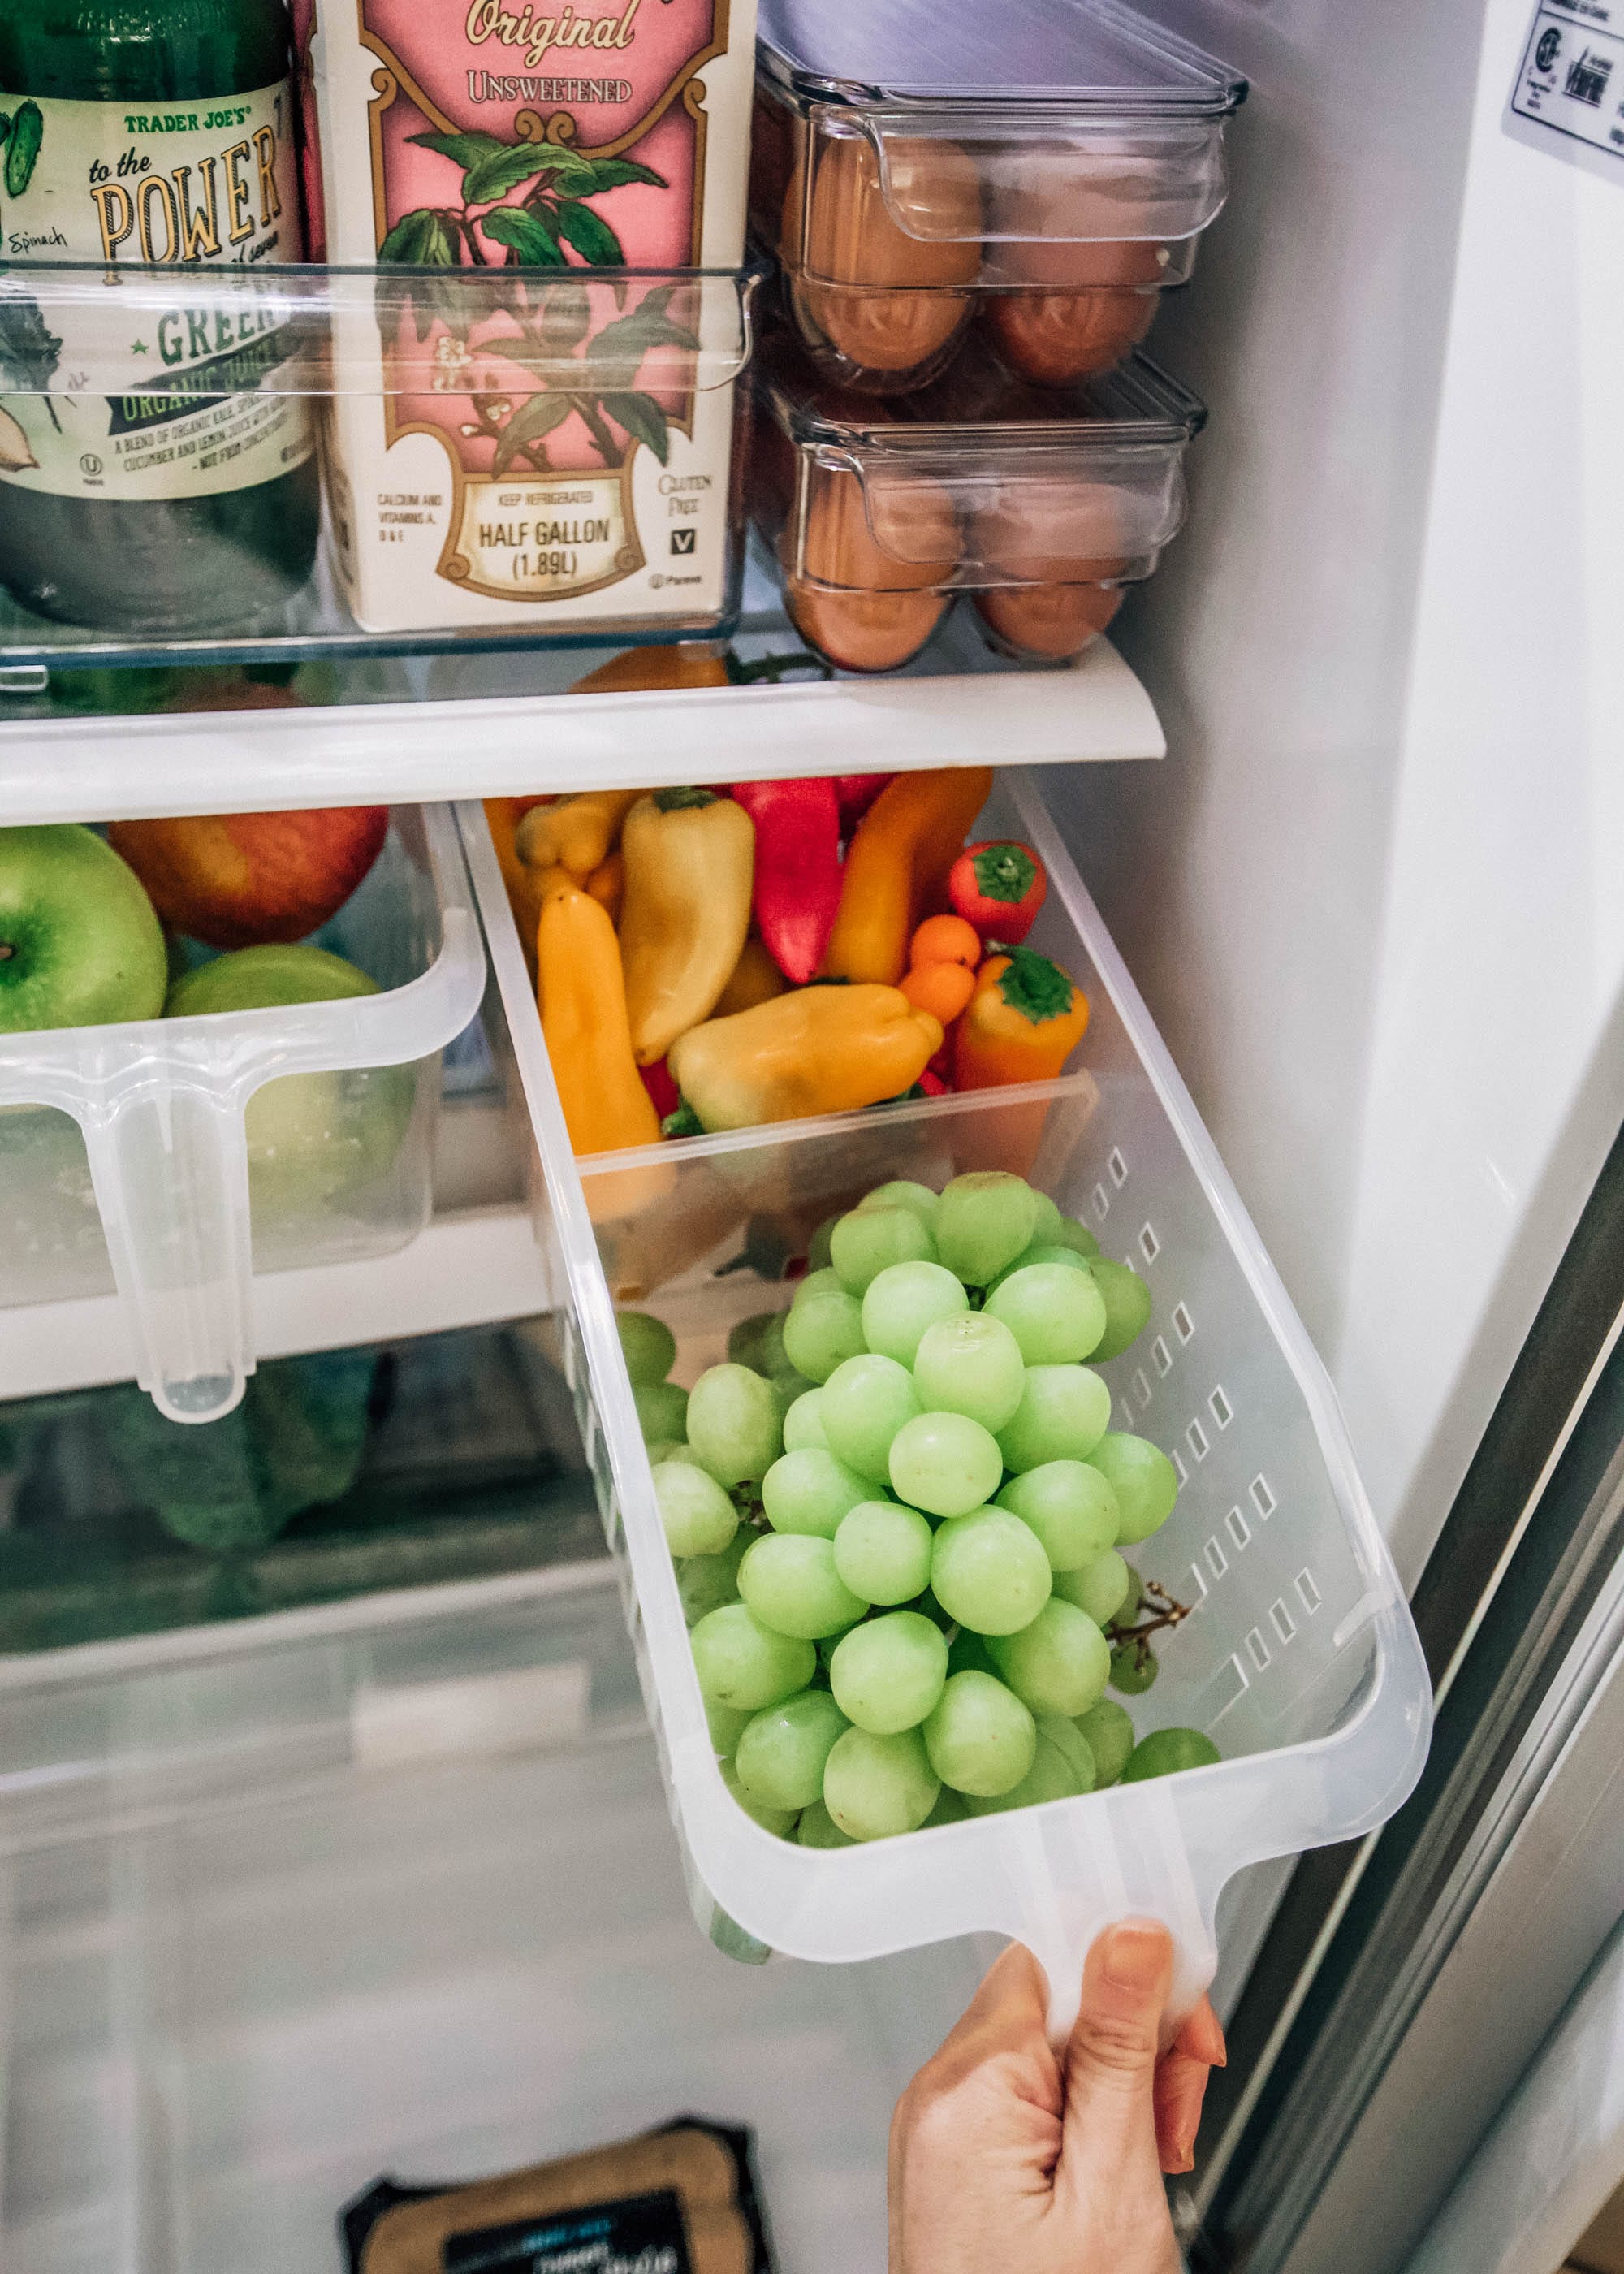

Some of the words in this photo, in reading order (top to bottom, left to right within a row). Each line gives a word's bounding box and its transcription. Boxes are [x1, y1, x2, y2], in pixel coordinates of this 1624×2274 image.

[465, 0, 640, 67] Original
[466, 70, 633, 103] UNSWEETENED
[124, 115, 200, 134] TRADER
[205, 107, 247, 130] JOE'S
[89, 158, 112, 184] to
[117, 146, 153, 178] the
[90, 124, 283, 286] POWER
[8, 227, 69, 254] Spinach
[158, 308, 276, 365] GREEN
[123, 447, 174, 471] CUCUMBER
[658, 473, 712, 495] GLUTEN
[377, 493, 419, 507] CALCIUM
[421, 494, 443, 506] AND
[497, 491, 520, 507] KEEP
[525, 489, 594, 507] REFRIGERATED
[668, 497, 698, 517] FREE
[378, 512, 423, 525] VITAMINS
[479, 522, 528, 547] HALF
[534, 517, 611, 546] GALLON
[512, 551, 577, 581] (1.89L)
